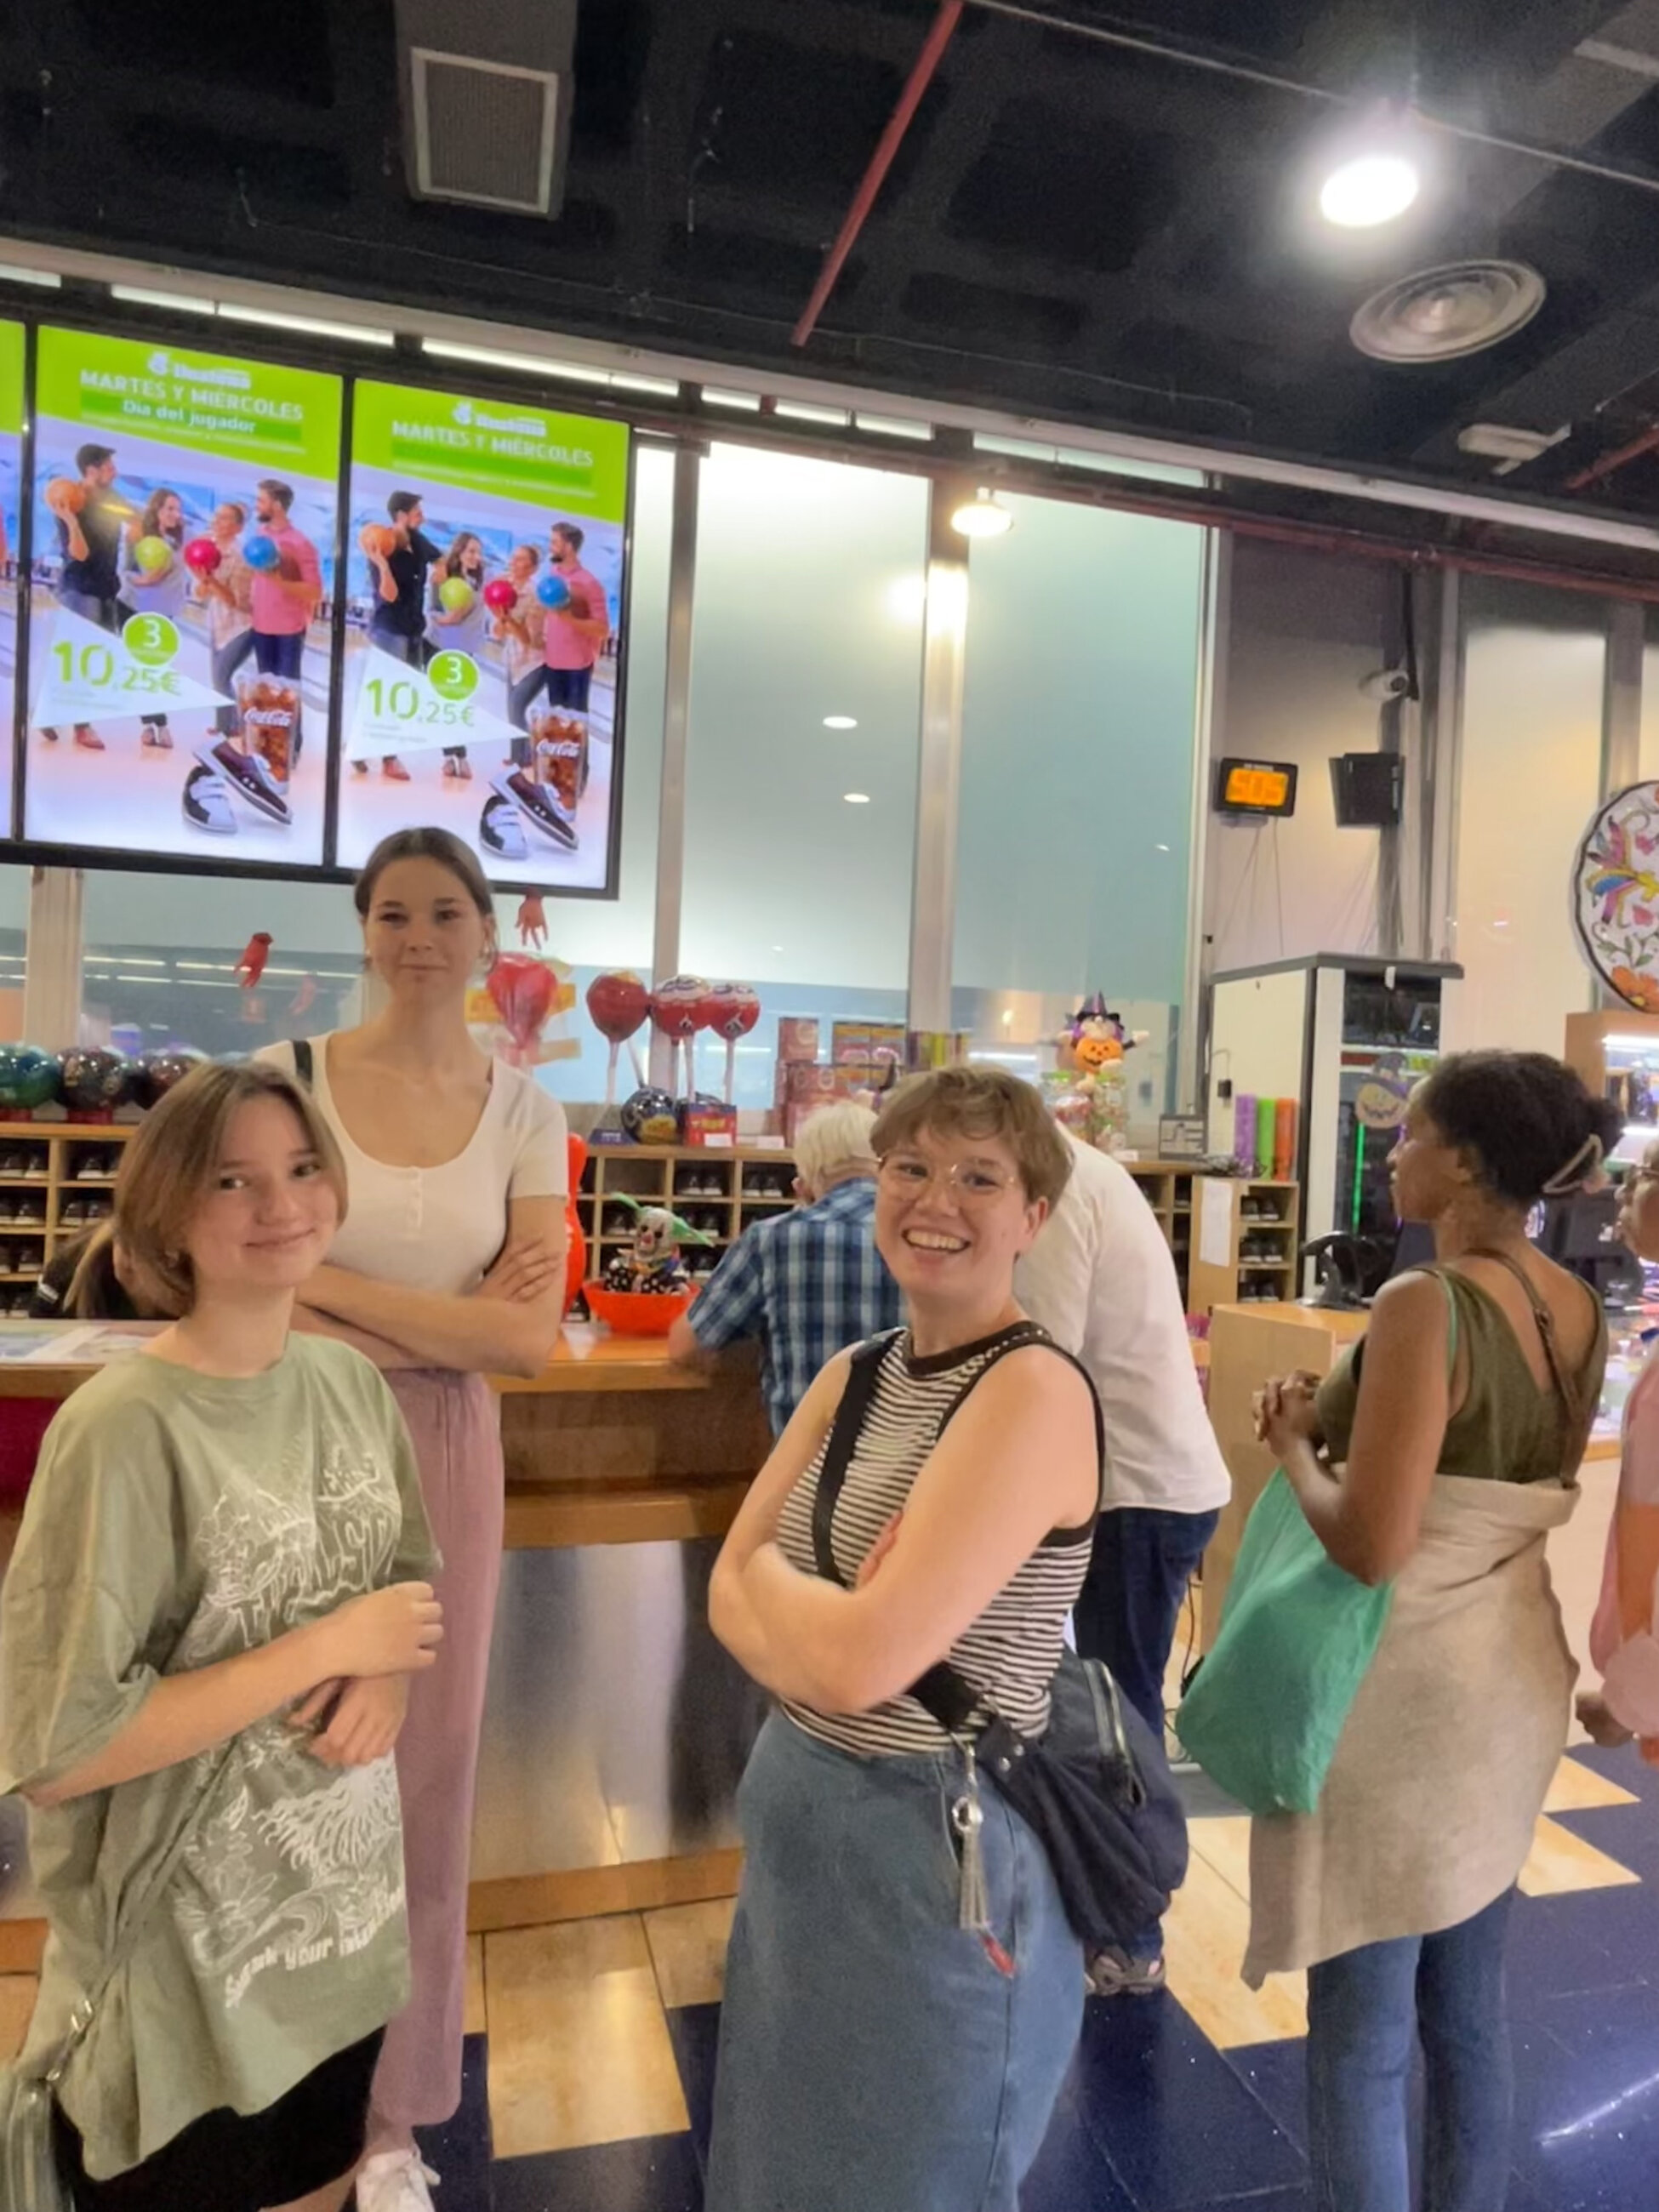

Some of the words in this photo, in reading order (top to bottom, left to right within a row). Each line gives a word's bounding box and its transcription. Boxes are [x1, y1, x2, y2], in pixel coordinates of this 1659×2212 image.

[80, 369, 166, 399] MARTES
[173, 385, 184, 402] Y
[156, 406, 184, 420] del
[189, 412, 256, 433] jugador
[392, 419, 470, 448] MARTES
[142, 618, 162, 648] 3
[446, 656, 463, 684] 3
